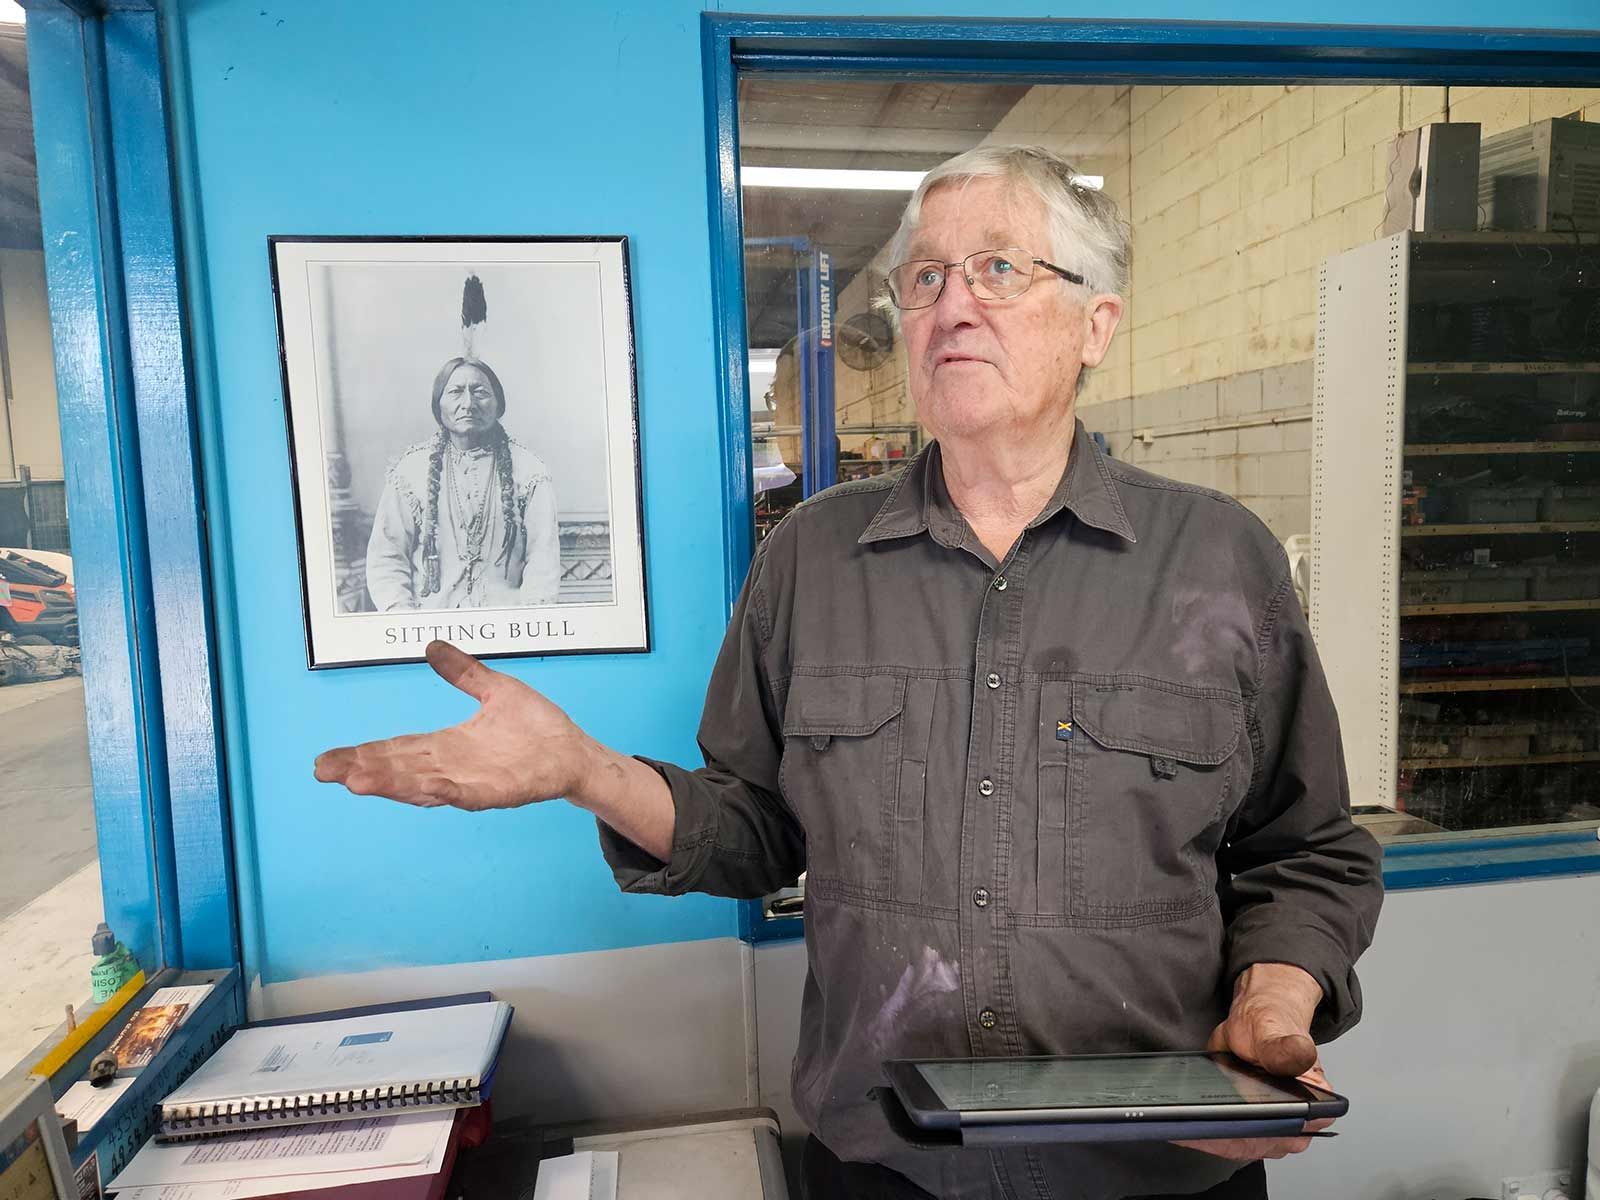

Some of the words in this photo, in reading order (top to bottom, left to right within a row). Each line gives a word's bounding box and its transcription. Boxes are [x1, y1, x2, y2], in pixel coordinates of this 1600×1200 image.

[820, 251, 830, 280] LIFT
[821, 283, 831, 339] ROTARY
[385, 623, 496, 644] SITTING
[509, 620, 575, 639] BULL
